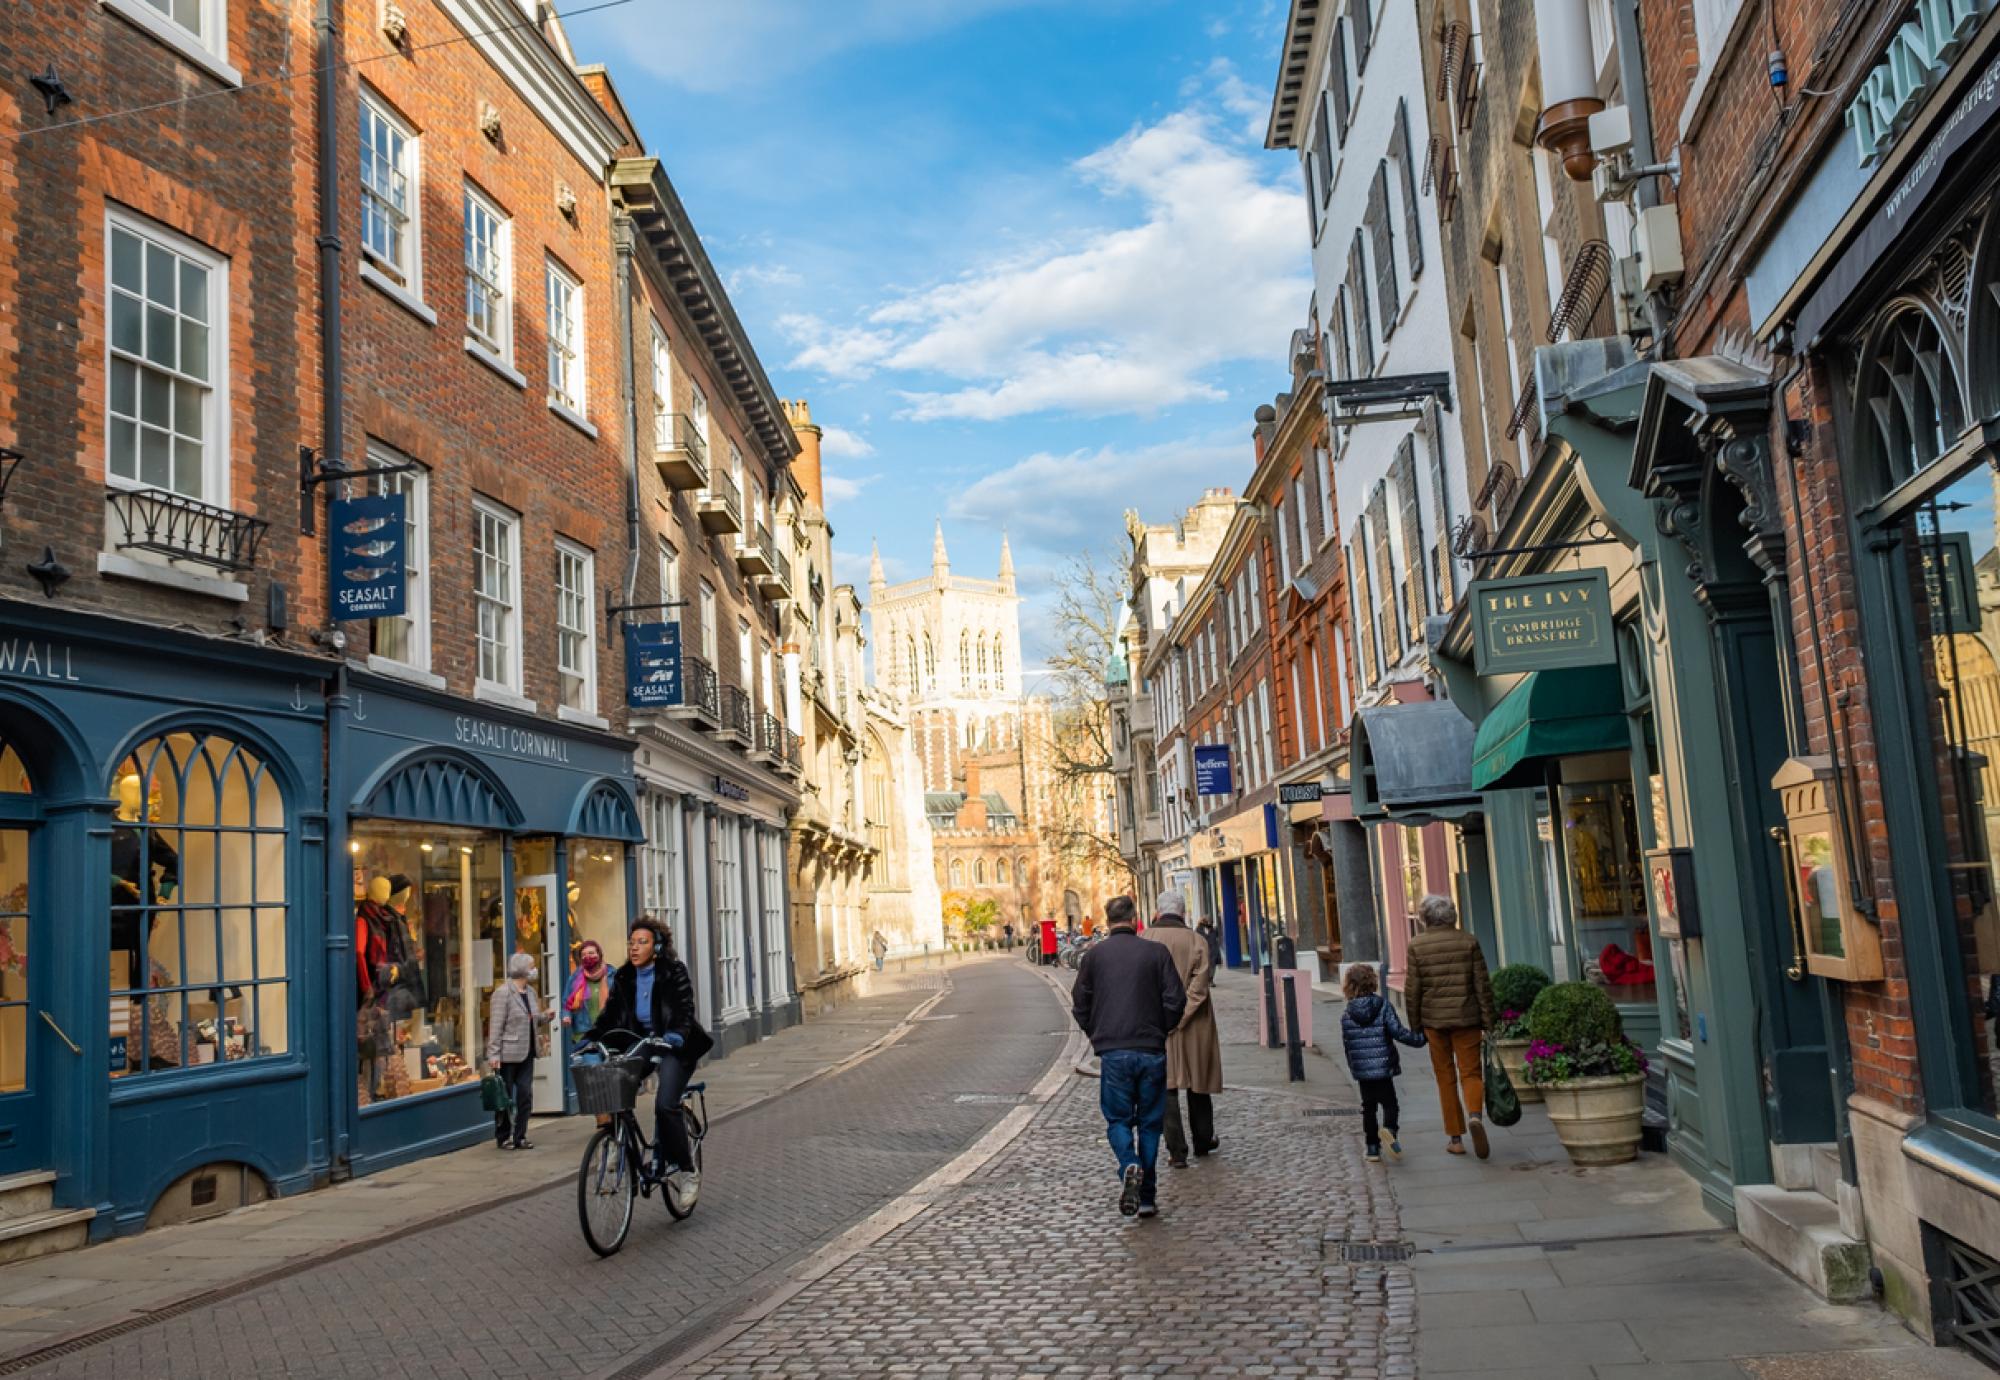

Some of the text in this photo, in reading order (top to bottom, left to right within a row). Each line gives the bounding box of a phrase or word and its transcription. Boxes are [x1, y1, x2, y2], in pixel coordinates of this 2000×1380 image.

[339, 585, 397, 604] SEASALT
[1488, 587, 1592, 612] THE IVY
[1503, 617, 1582, 633] CAMBRIDGE
[1507, 630, 1581, 646] BRASSERIE
[633, 684, 674, 697] SEASALT
[455, 716, 569, 763] SEASALT CORNWALL
